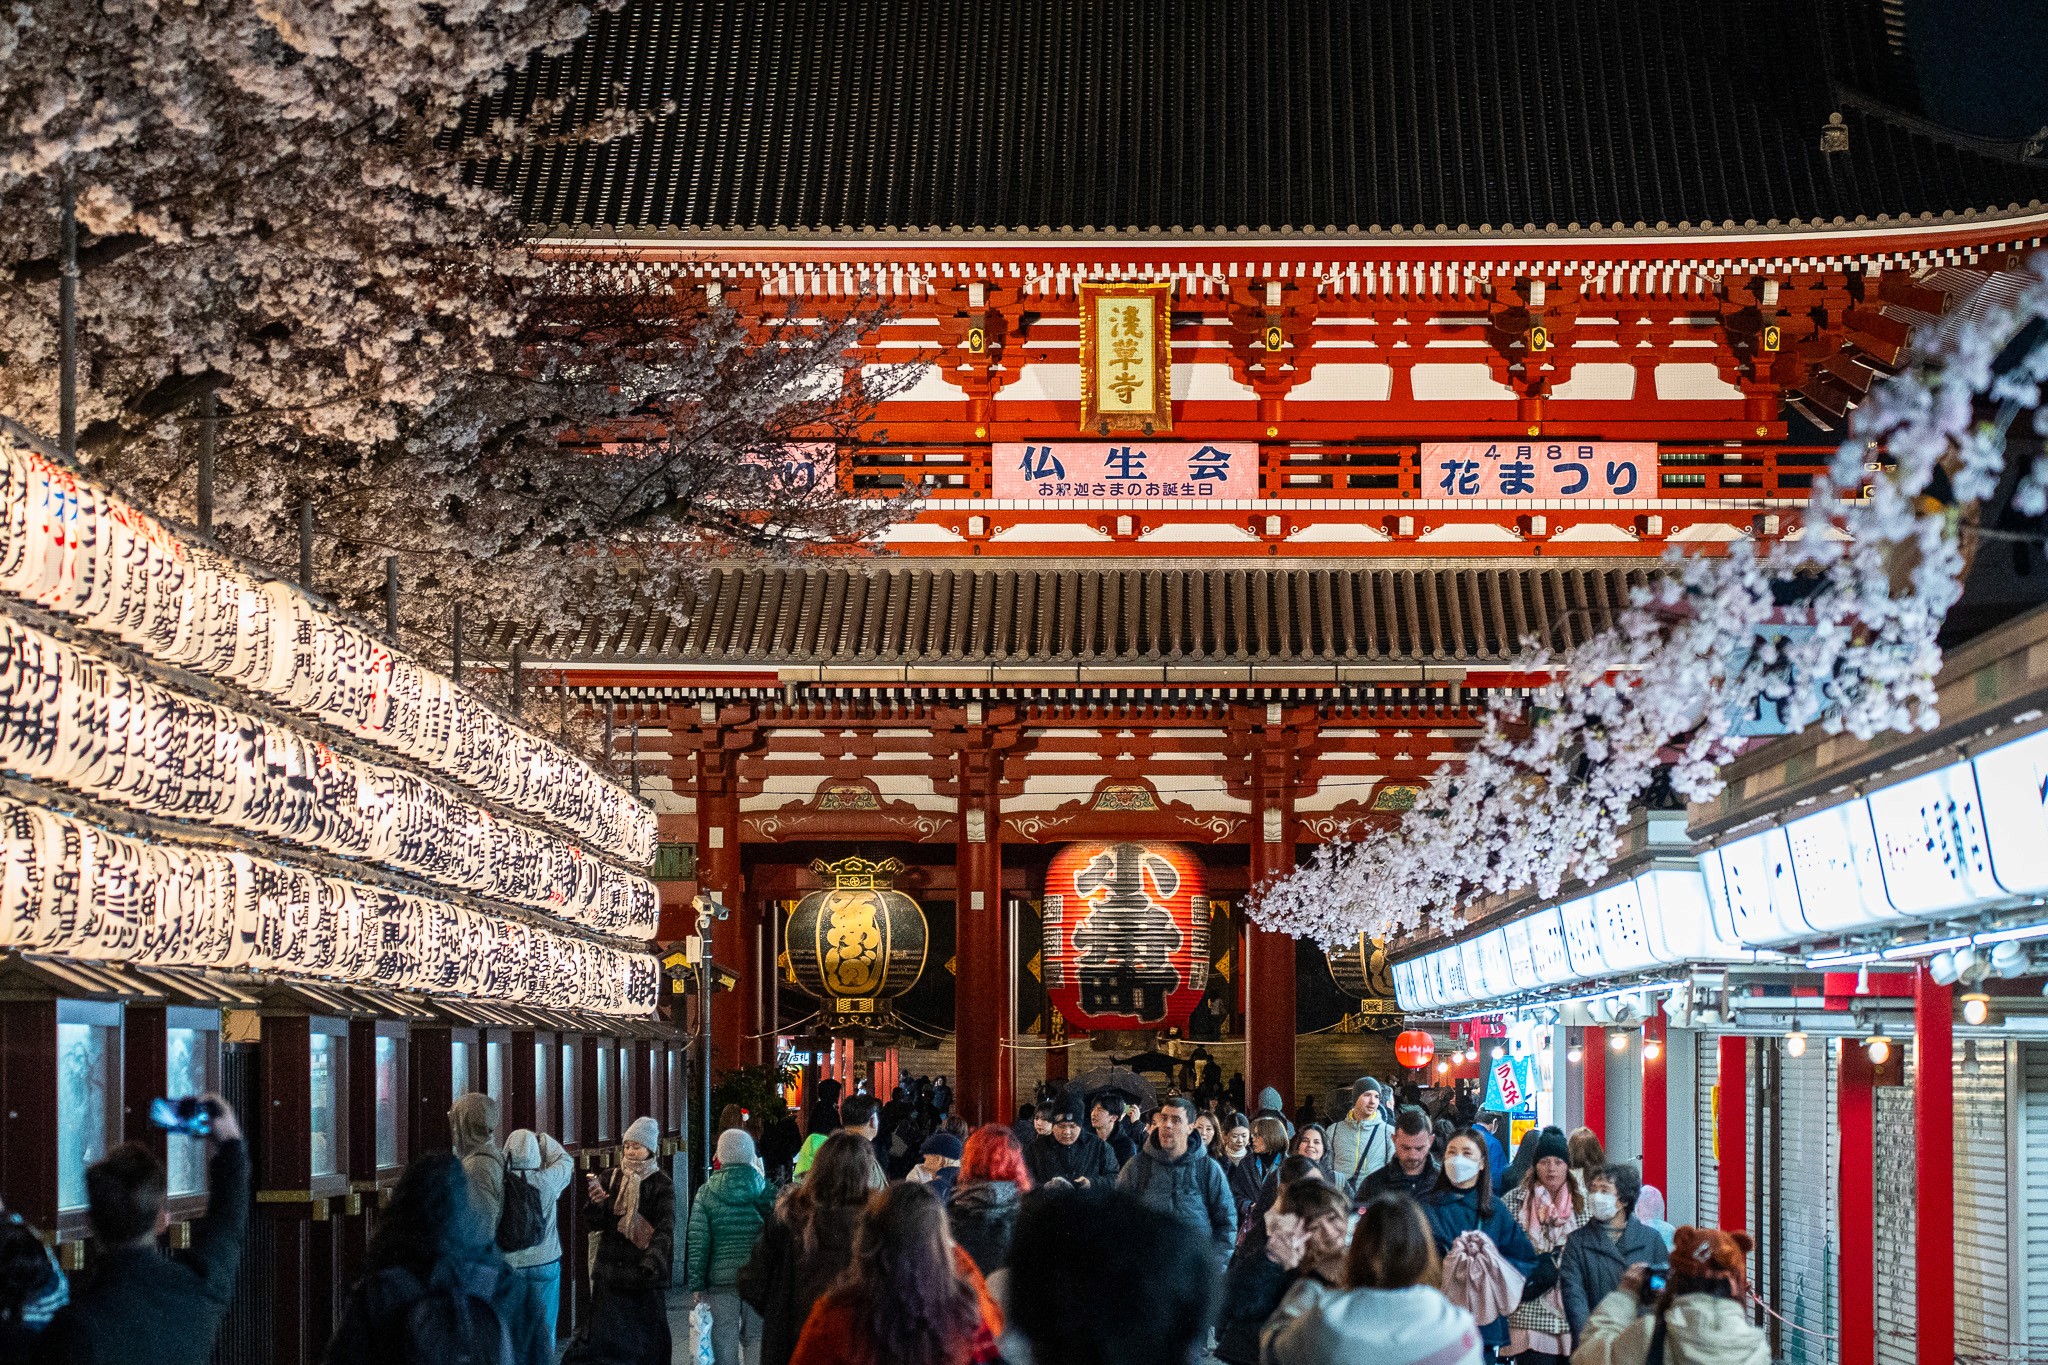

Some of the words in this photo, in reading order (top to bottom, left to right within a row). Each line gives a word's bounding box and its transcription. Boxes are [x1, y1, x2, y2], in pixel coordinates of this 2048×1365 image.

[1018, 445, 1232, 481] 仏生会
[1484, 445, 1594, 460] 4月8日
[1038, 482, 1214, 497] お釈迦さまのお誕生日
[1439, 459, 1638, 496] 花まつり
[1497, 1063, 1520, 1105] ラムネ
